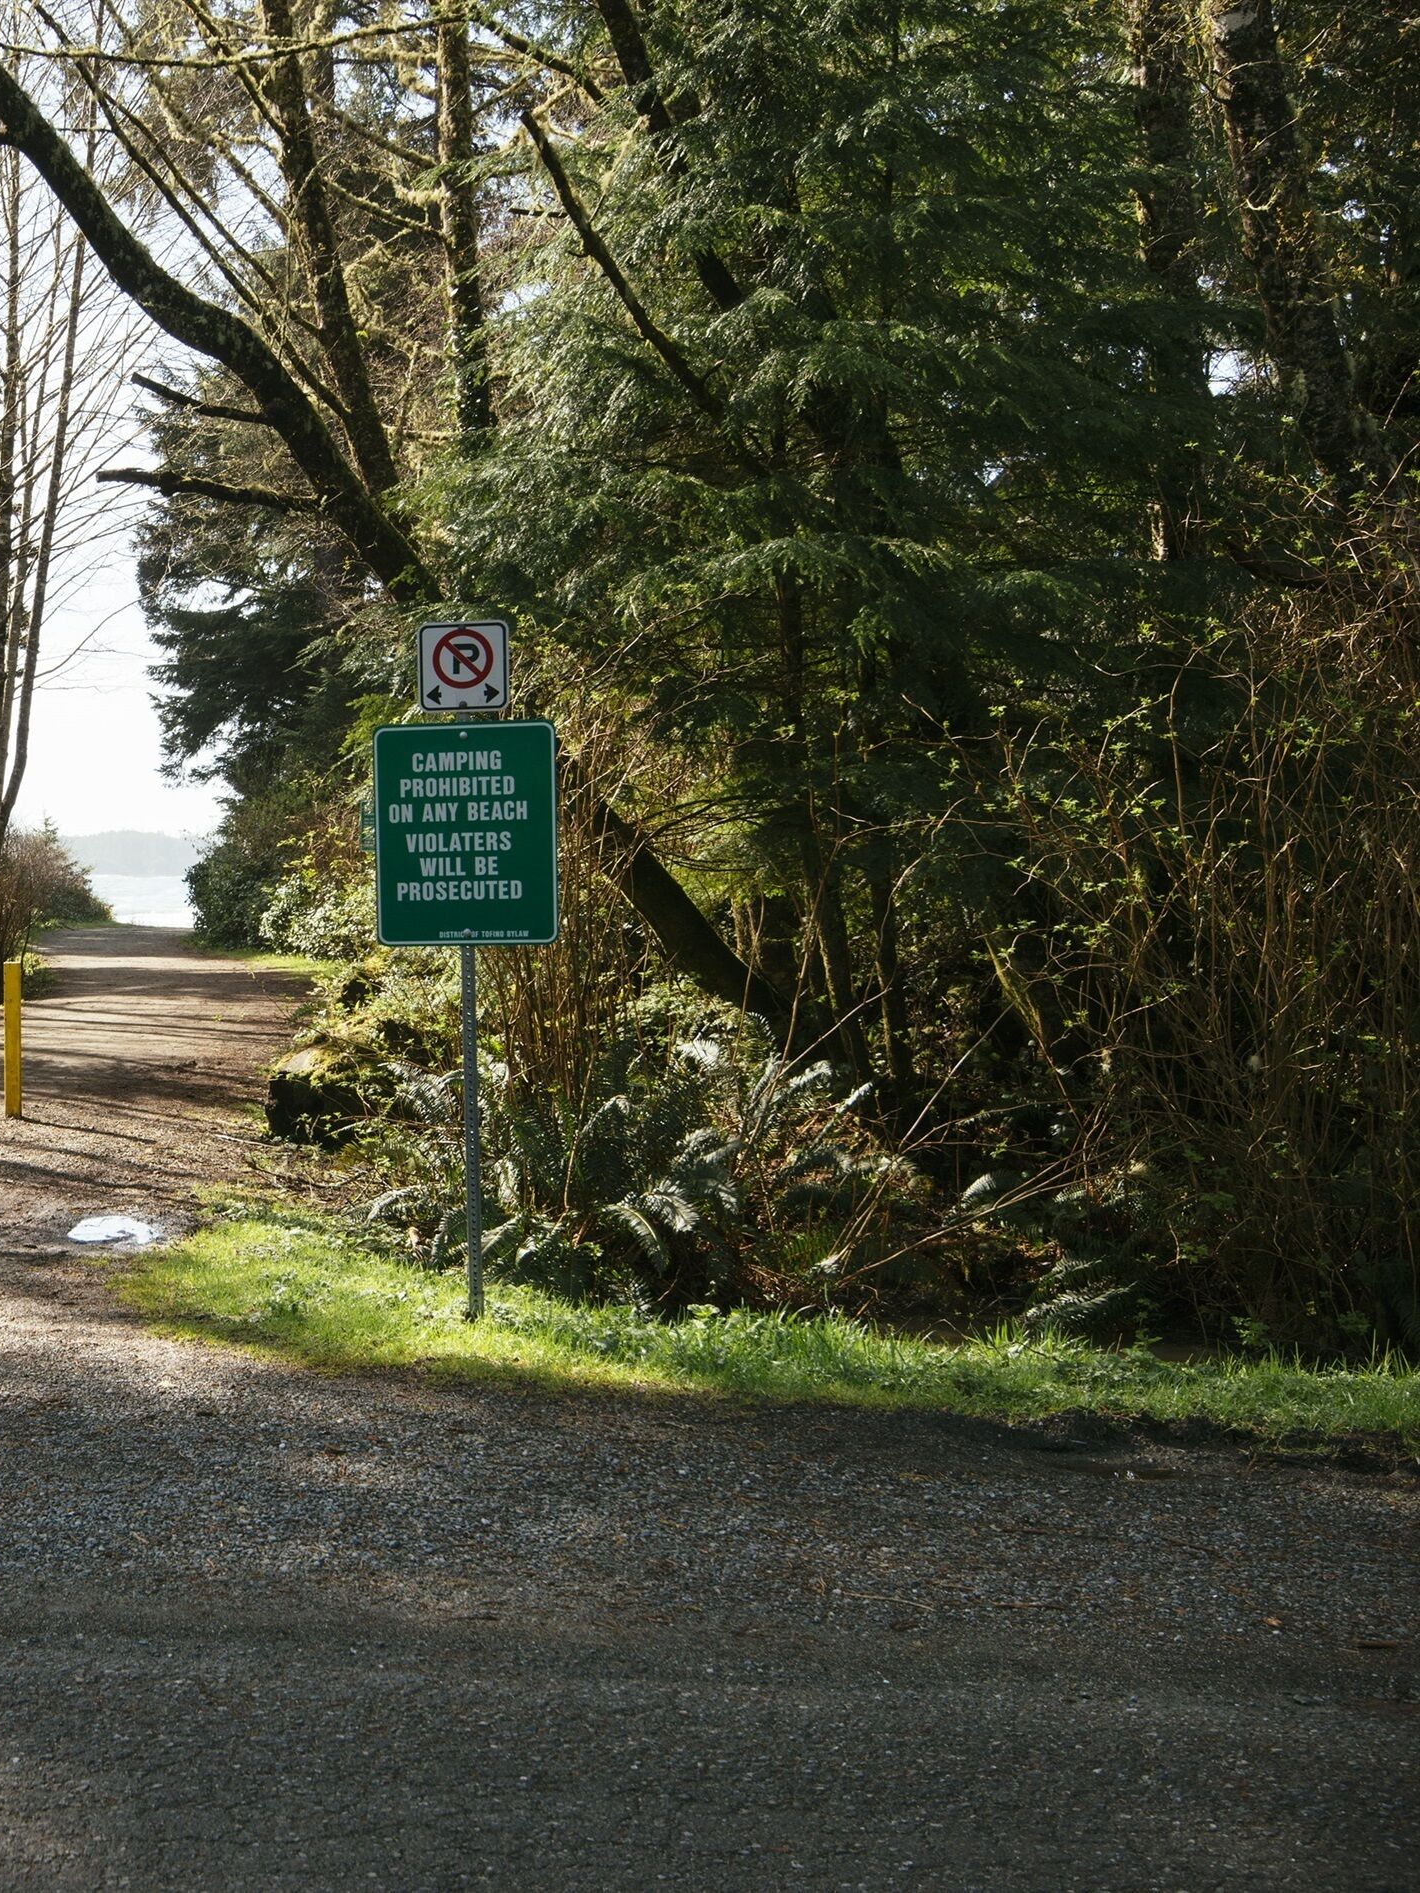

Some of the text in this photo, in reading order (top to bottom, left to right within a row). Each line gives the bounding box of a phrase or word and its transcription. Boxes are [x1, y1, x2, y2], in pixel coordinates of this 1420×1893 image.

[411, 750, 502, 773] CAMPING
[399, 775, 516, 798] PROHIBITED
[388, 800, 528, 824] ON ANY BEACH
[405, 831, 512, 853] VIOLATERS
[419, 856, 499, 877] WILL BE
[397, 880, 522, 901] PROSECUTED
[439, 930, 469, 939] DISTRIC
[481, 930, 505, 938] TOFINO
